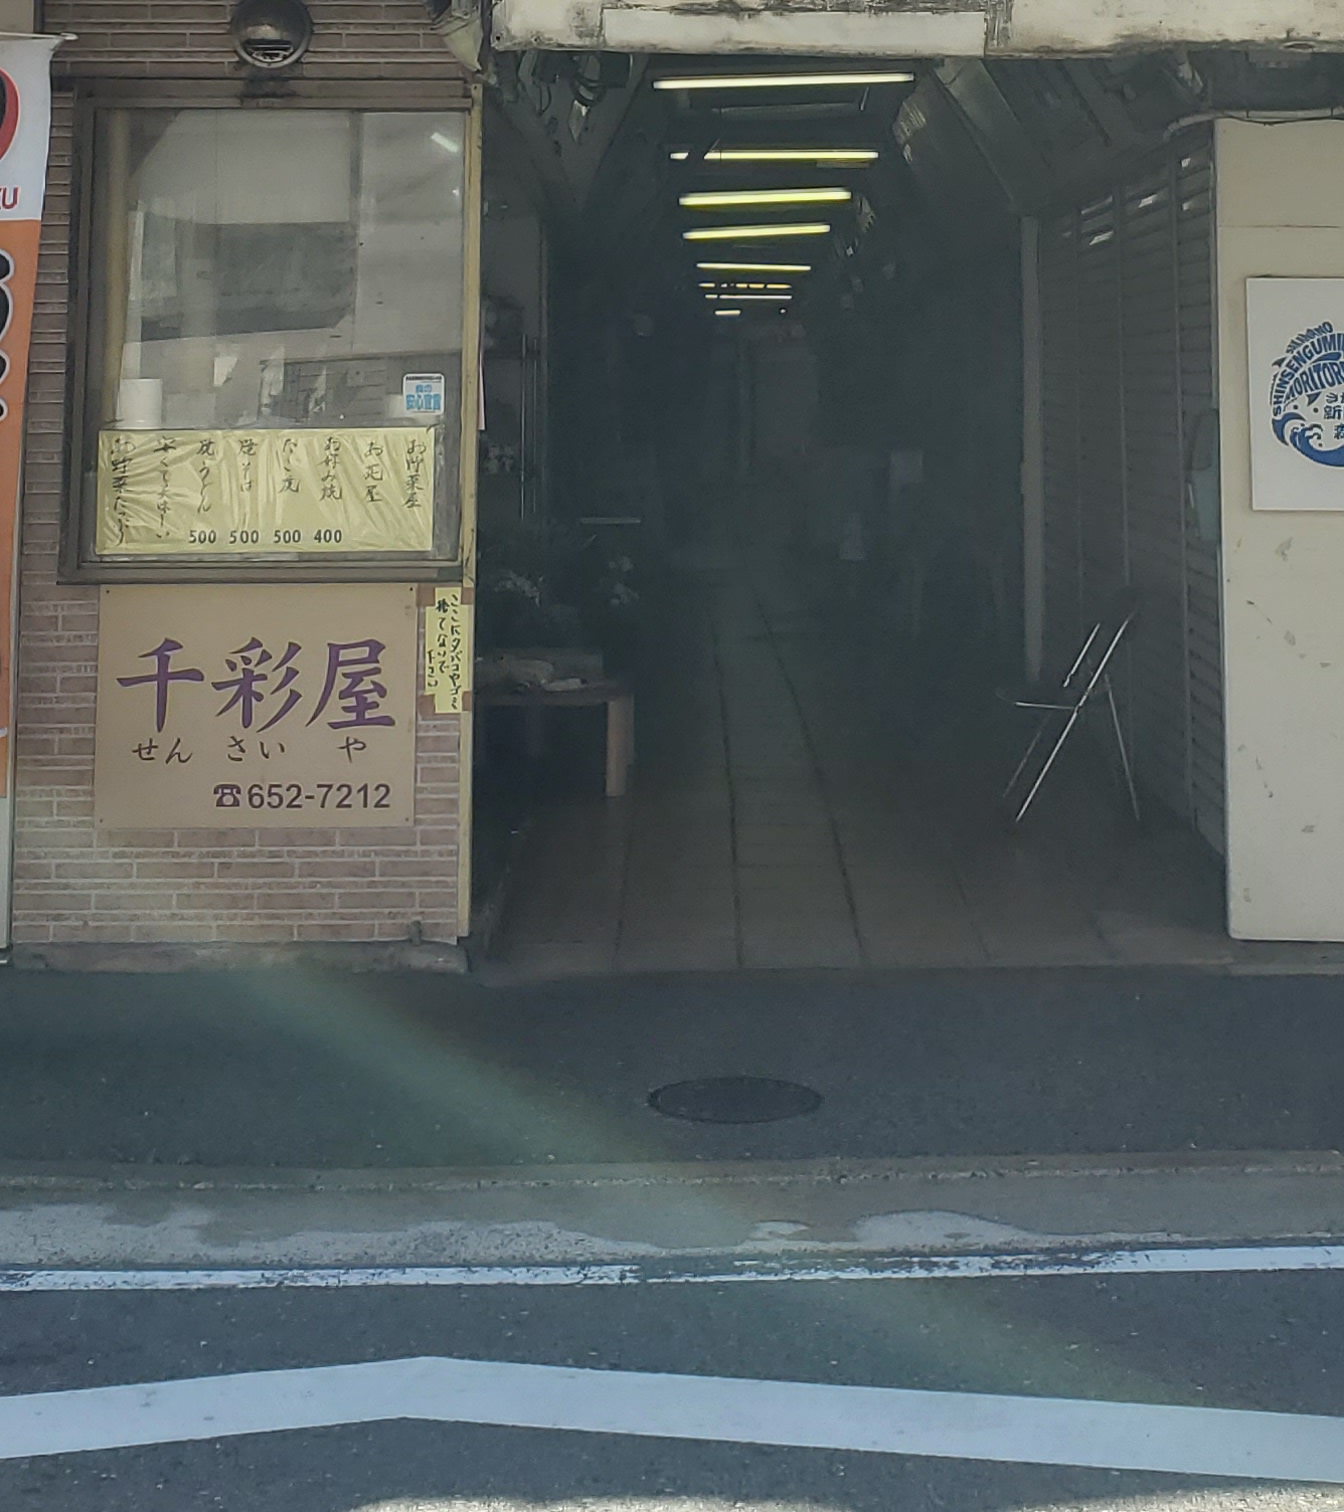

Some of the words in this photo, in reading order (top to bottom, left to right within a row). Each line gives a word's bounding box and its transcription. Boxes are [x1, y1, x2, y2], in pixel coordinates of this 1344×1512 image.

[1273, 334, 1342, 416] SHINSENGUMI
[188, 530, 217, 544] 500
[229, 530, 260, 544] 500
[273, 530, 302, 544] 500
[313, 529, 343, 544] 400
[115, 637, 396, 733] 千彩屋
[248, 783, 391, 809] 652-7212
